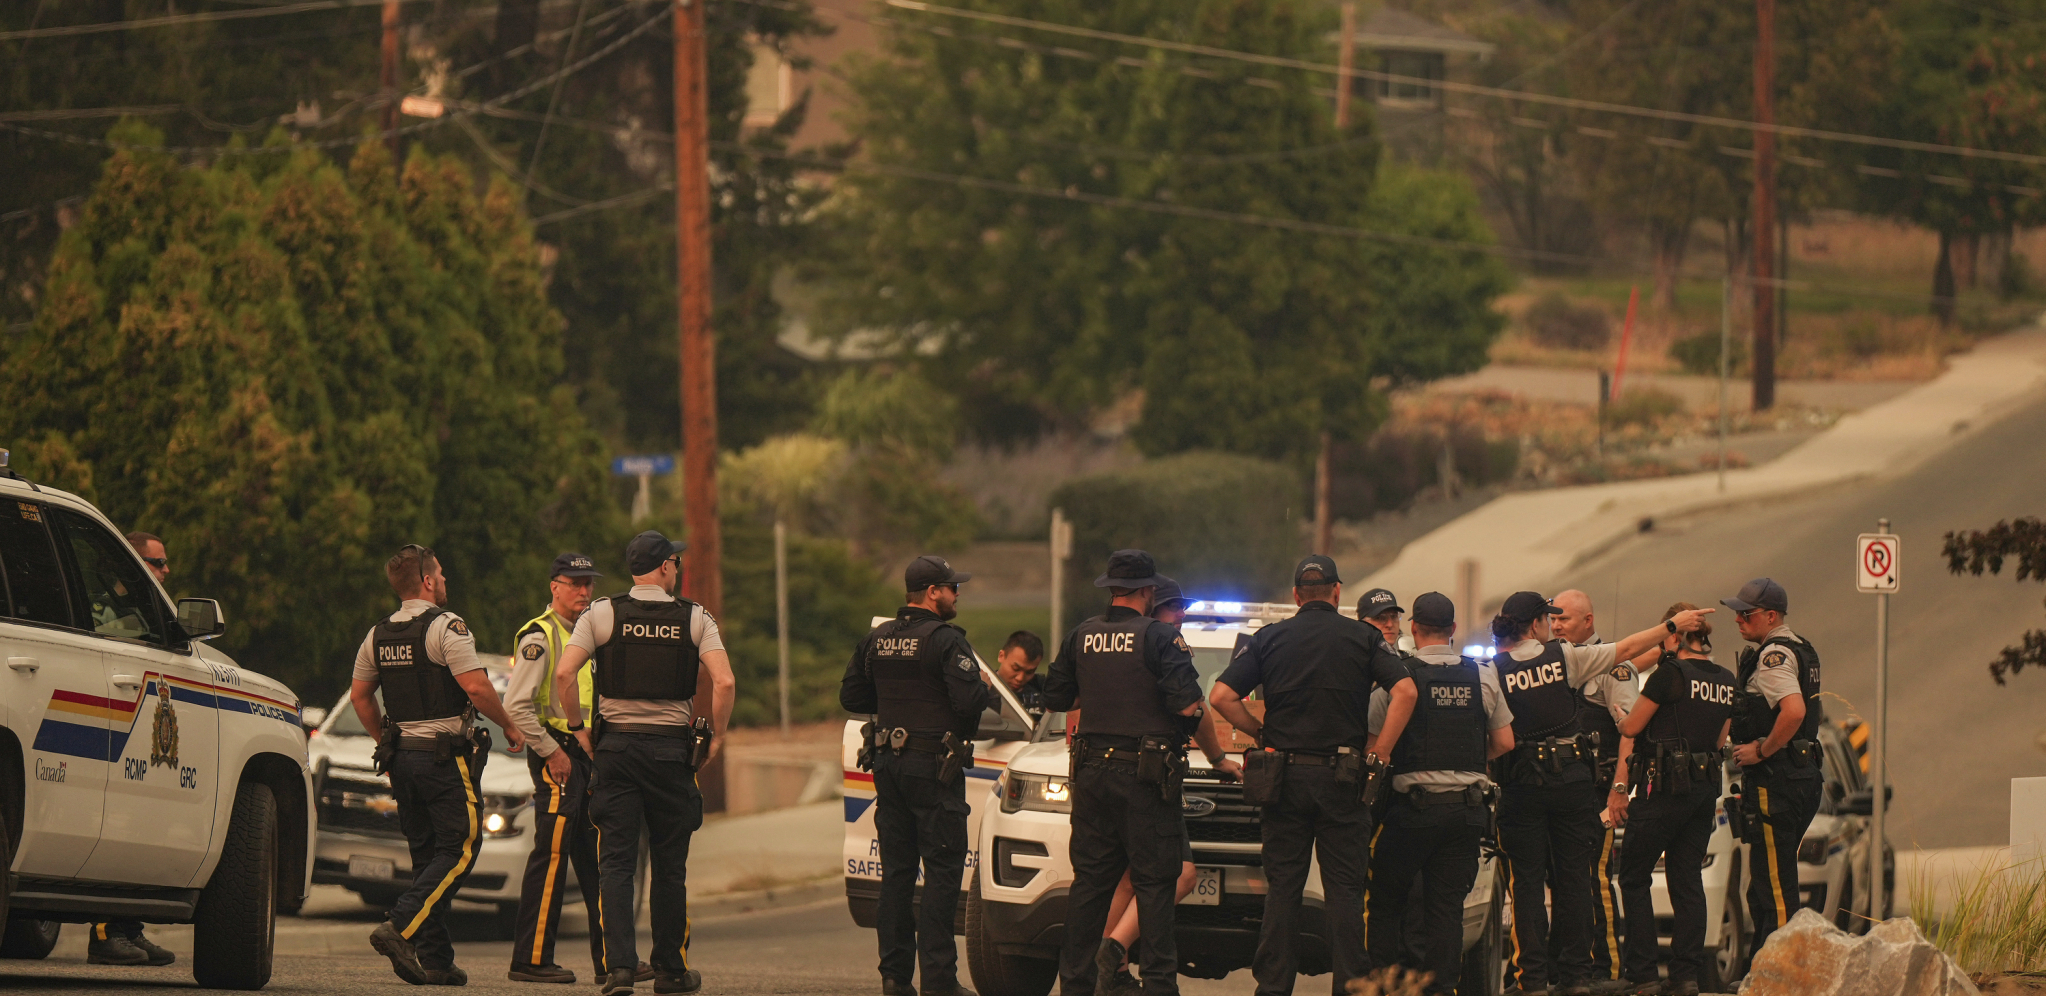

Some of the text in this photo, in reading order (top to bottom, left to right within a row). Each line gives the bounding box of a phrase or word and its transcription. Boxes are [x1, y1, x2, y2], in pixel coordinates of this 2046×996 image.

[622, 623, 681, 640] POLICE
[379, 644, 413, 661] POLICE
[876, 638, 919, 651] POLICE
[1083, 632, 1135, 654] POLICE
[1505, 661, 1564, 694] POLICE
[1430, 686, 1472, 699] POLICE
[1436, 698, 1453, 706] RCMP
[1456, 698, 1468, 706] GRC
[1690, 679, 1735, 706] POLICE
[250, 701, 286, 722] POLICE
[35, 757, 67, 783] Canada
[124, 757, 148, 782] RCMP
[180, 765, 197, 790] GRC
